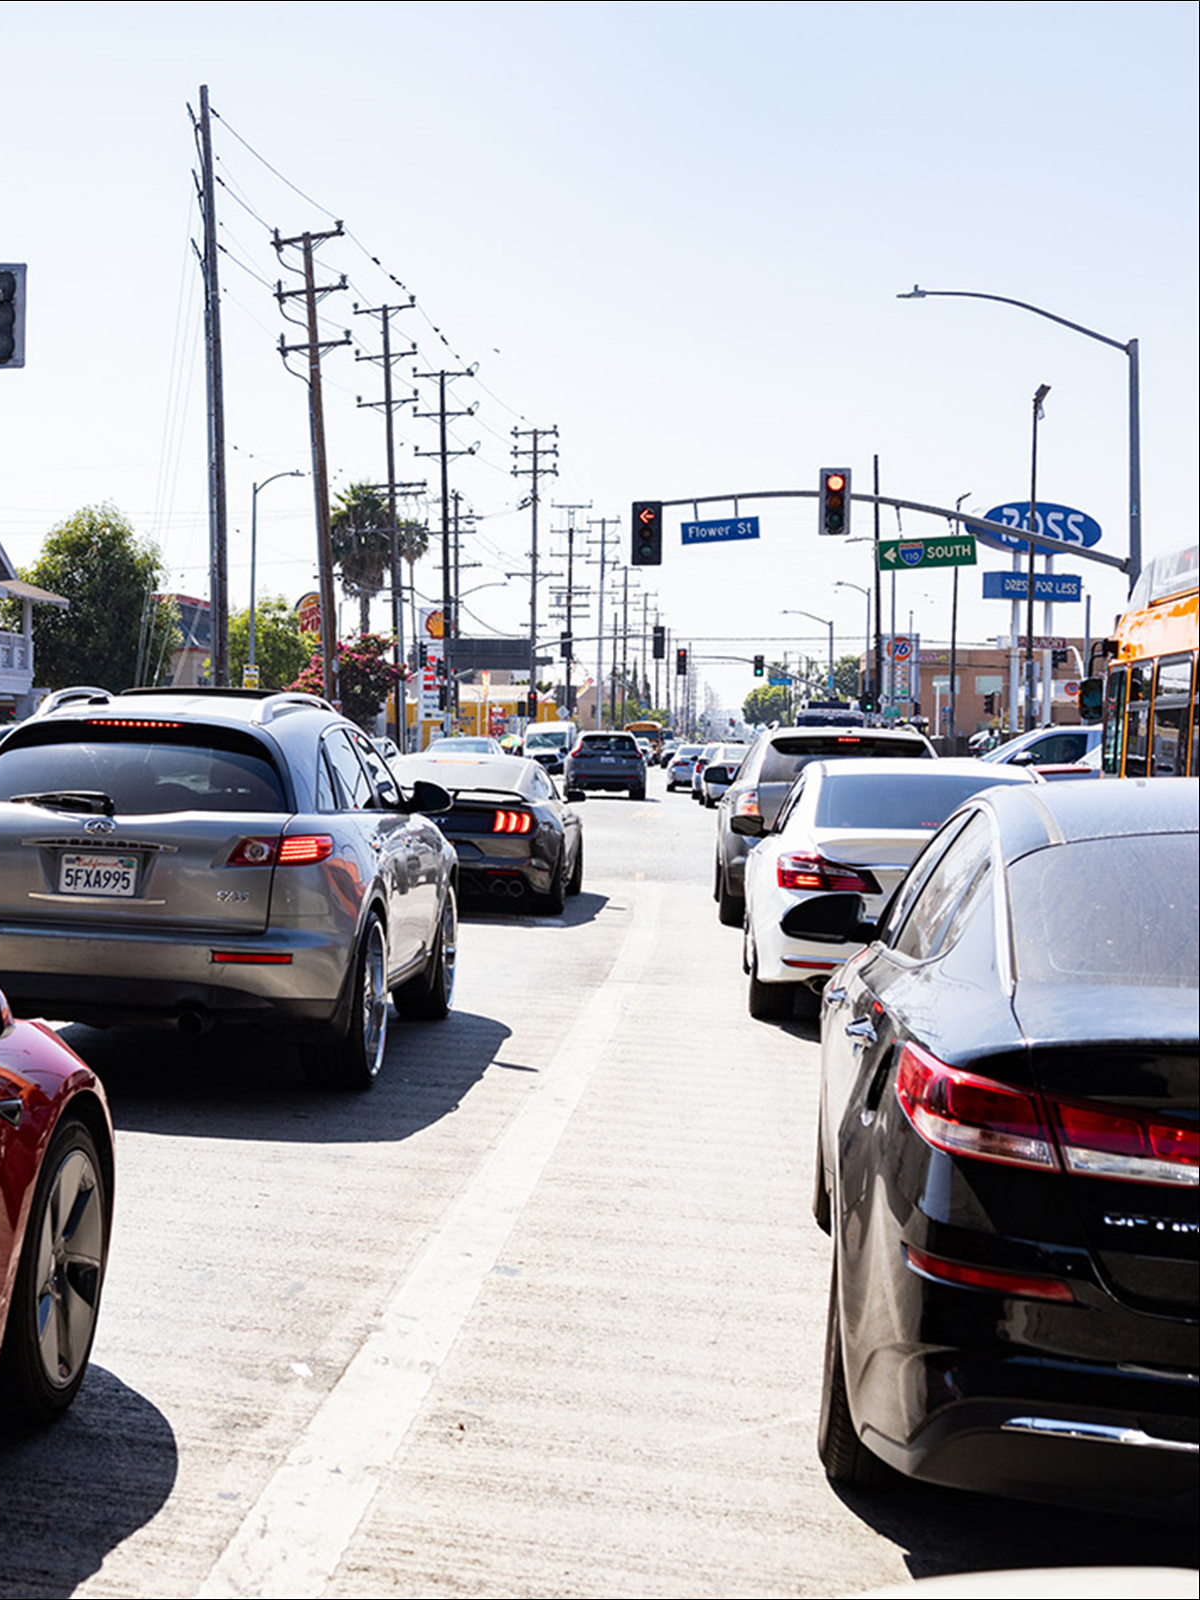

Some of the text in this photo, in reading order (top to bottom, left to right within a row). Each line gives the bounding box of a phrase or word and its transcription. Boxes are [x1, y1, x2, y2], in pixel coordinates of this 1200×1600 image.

[688, 522, 752, 538] Flower St
[1002, 508, 1084, 545] ROSS
[905, 544, 971, 561] 110 SOUTH
[1004, 579, 1078, 595] DRES FOR LESS
[893, 642, 908, 655] 76
[76, 857, 122, 869] California
[64, 867, 131, 890] 5FXA995
